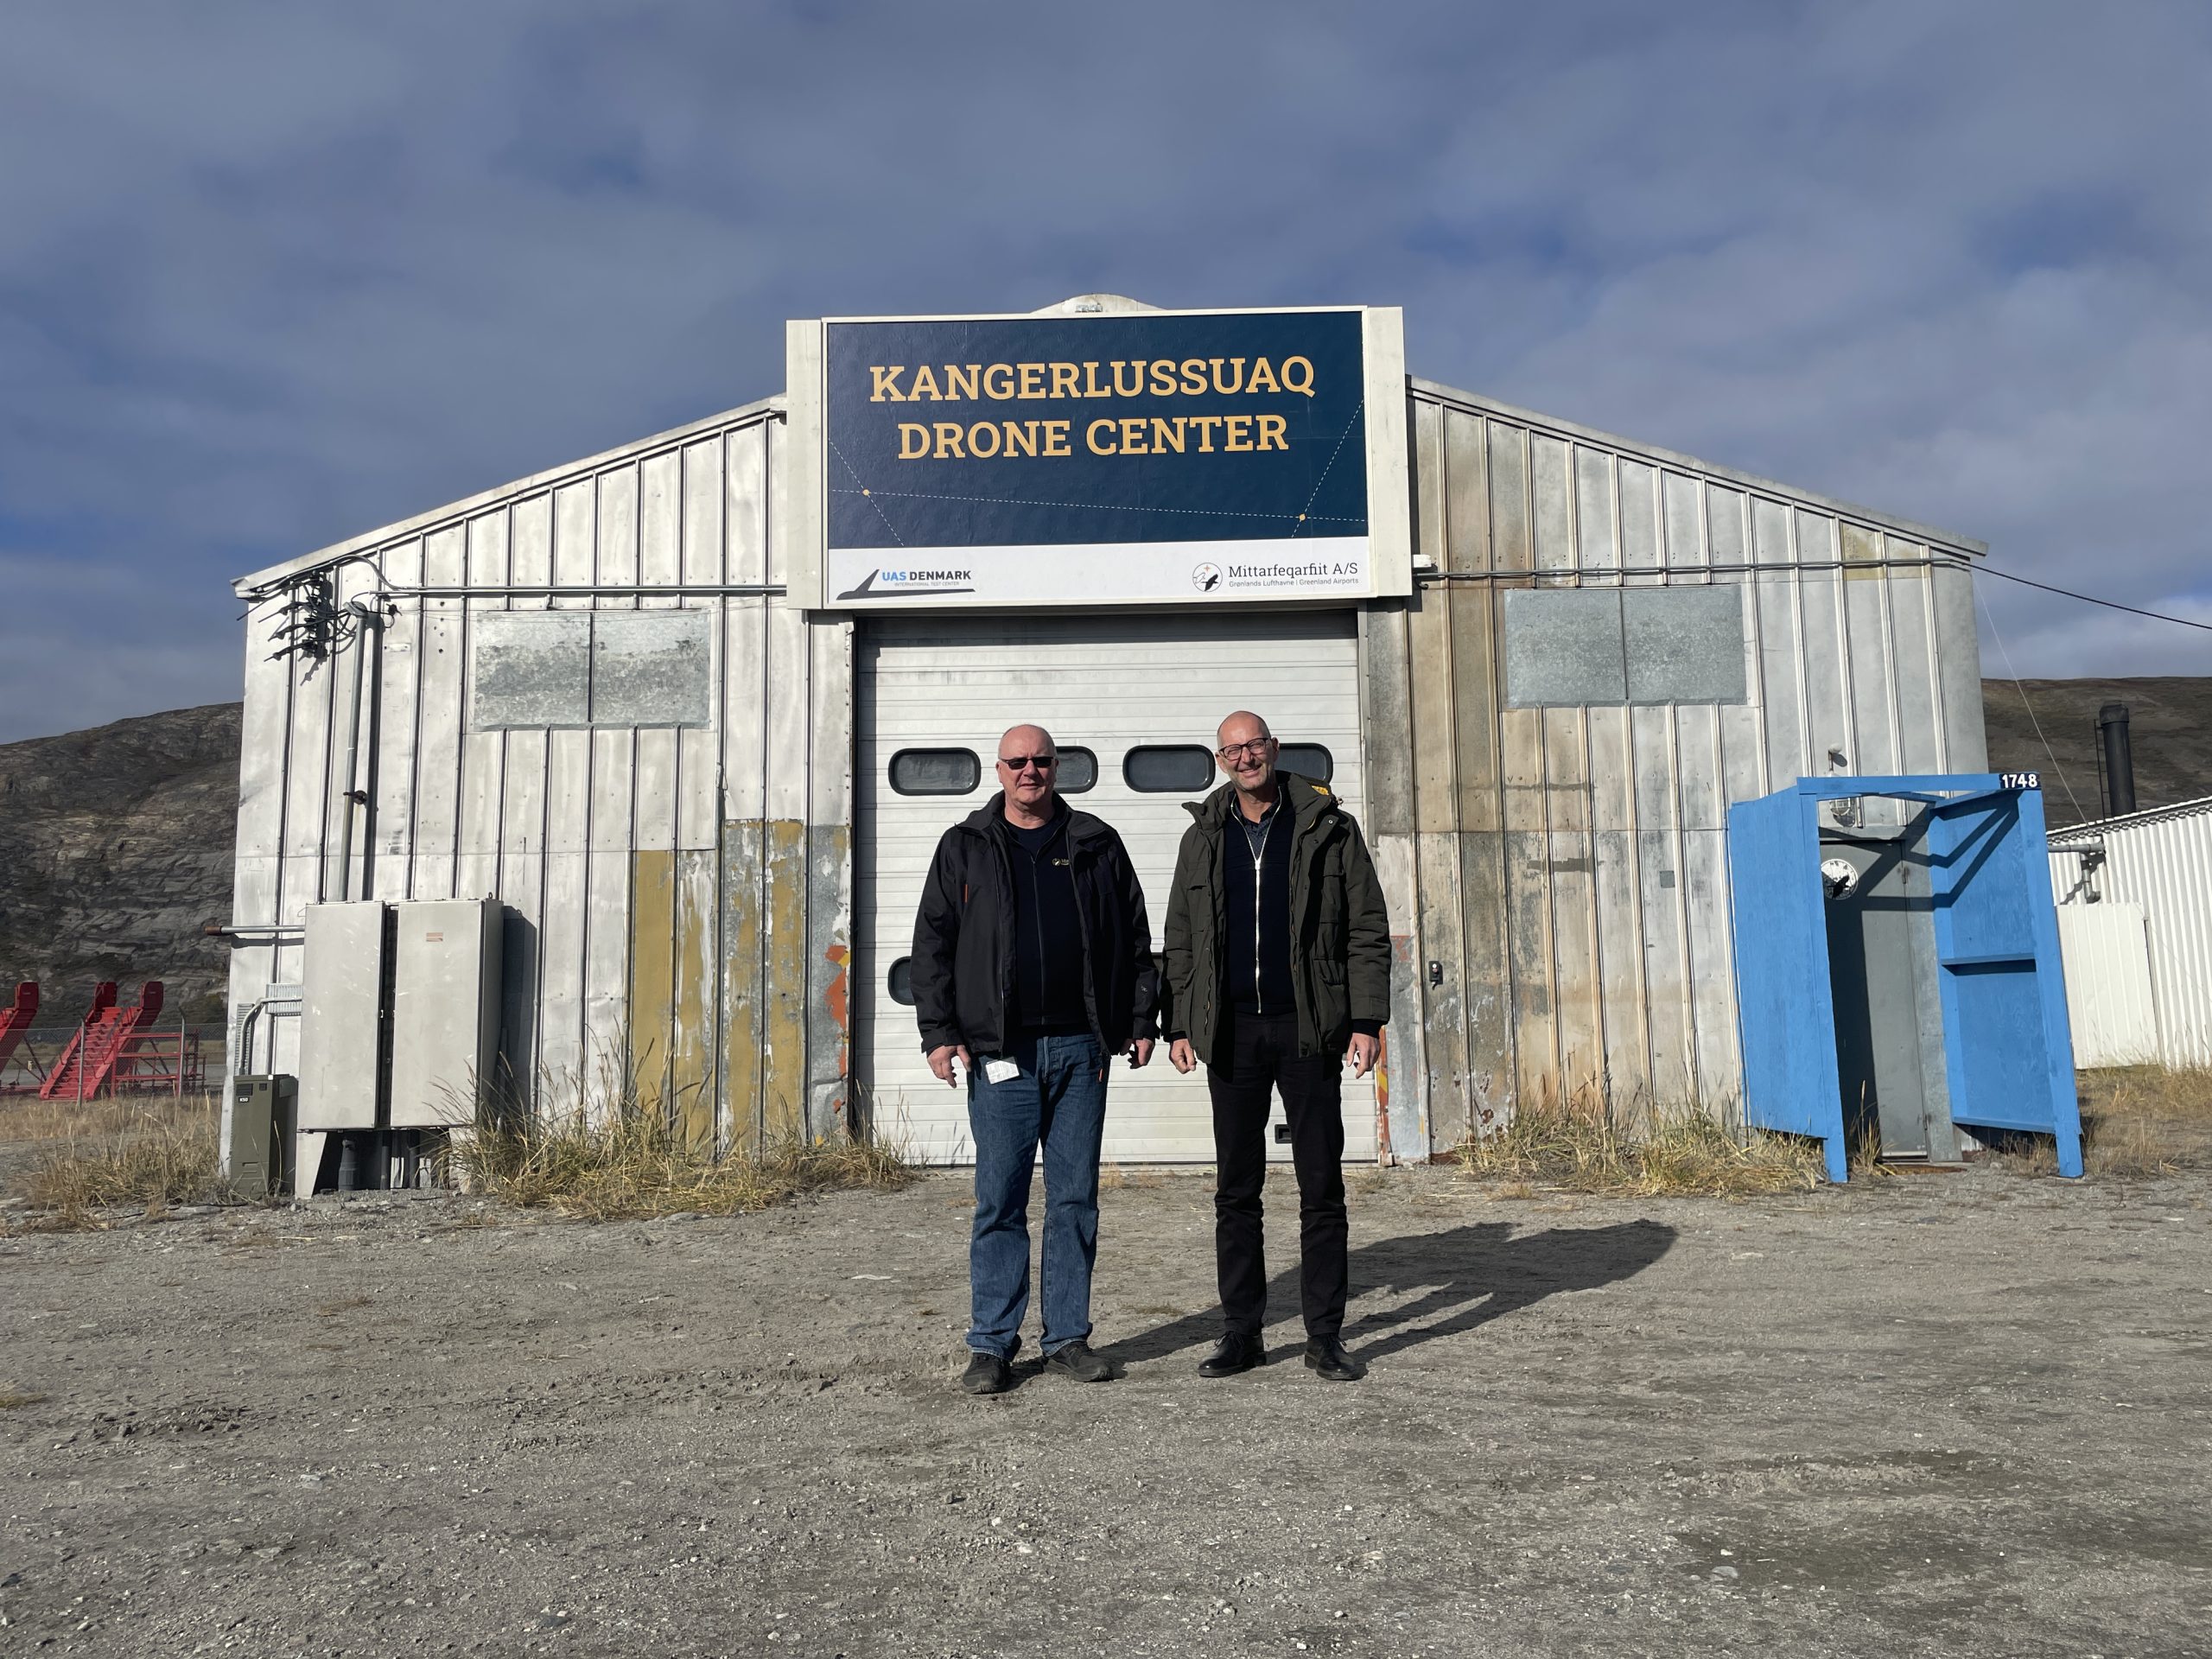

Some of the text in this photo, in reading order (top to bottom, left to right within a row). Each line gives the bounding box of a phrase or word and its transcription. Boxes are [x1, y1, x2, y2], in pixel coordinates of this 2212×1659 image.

[869, 355, 1316, 402] KANGERLUSSUAQ
[897, 414, 1289, 461] DRONE CENTER
[882, 570, 971, 582] UAS DENMARK
[1228, 562, 1358, 578] Mittarfeqarfiit A/S
[1332, 577, 1359, 586] Airports
[2002, 773, 2037, 788] 1748
